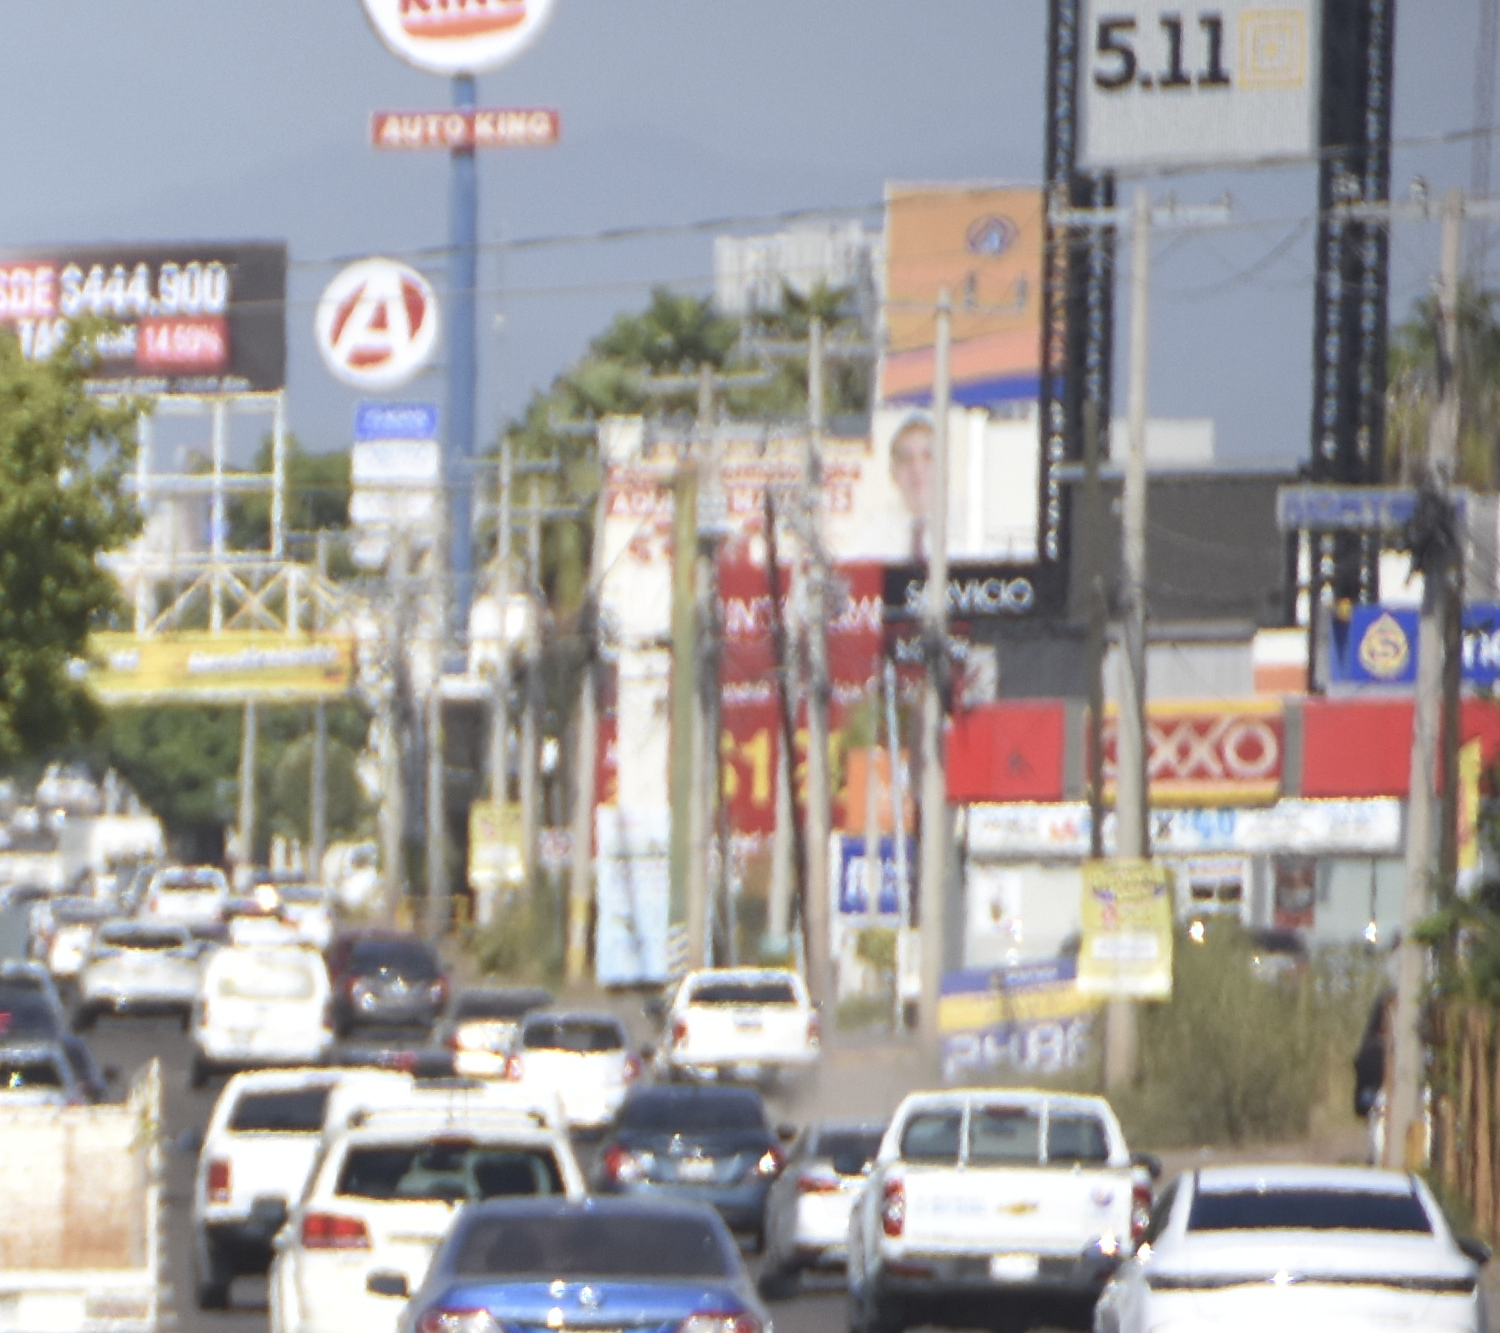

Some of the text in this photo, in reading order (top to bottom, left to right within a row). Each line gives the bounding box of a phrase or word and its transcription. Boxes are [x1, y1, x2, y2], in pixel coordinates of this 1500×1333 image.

[1094, 15, 1231, 90] 5.11
[379, 110, 553, 146] AUTO KING
[905, 577, 1034, 615] SVICIO
